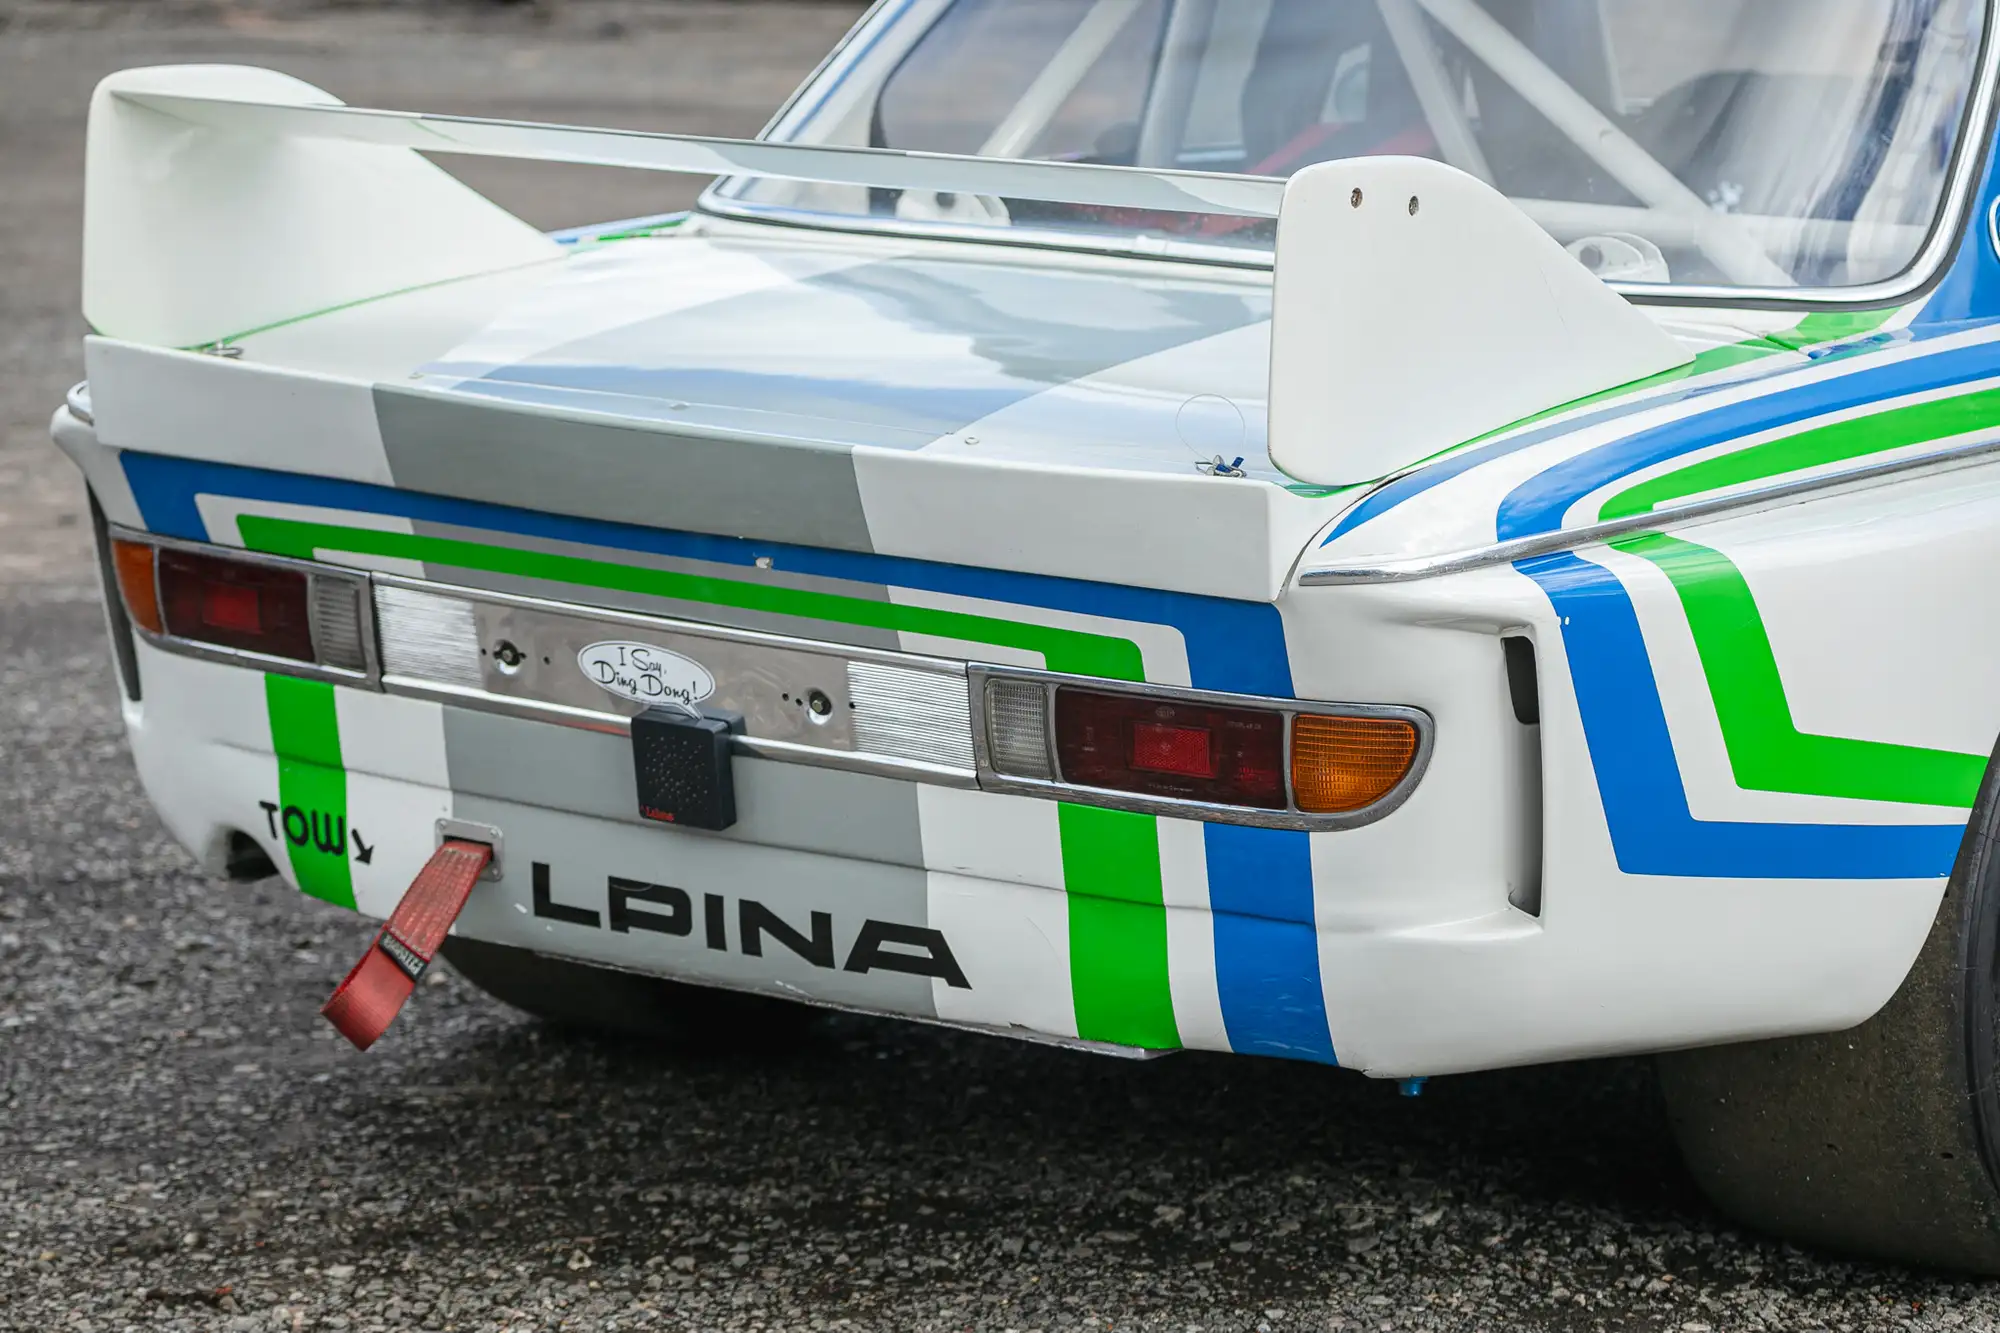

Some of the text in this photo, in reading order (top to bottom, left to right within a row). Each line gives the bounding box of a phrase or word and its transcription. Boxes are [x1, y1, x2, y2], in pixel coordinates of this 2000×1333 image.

[618, 647, 626, 666] I
[592, 660, 698, 705] Ding Dong!
[259, 800, 346, 856] TOW
[531, 860, 973, 990] LPINA
